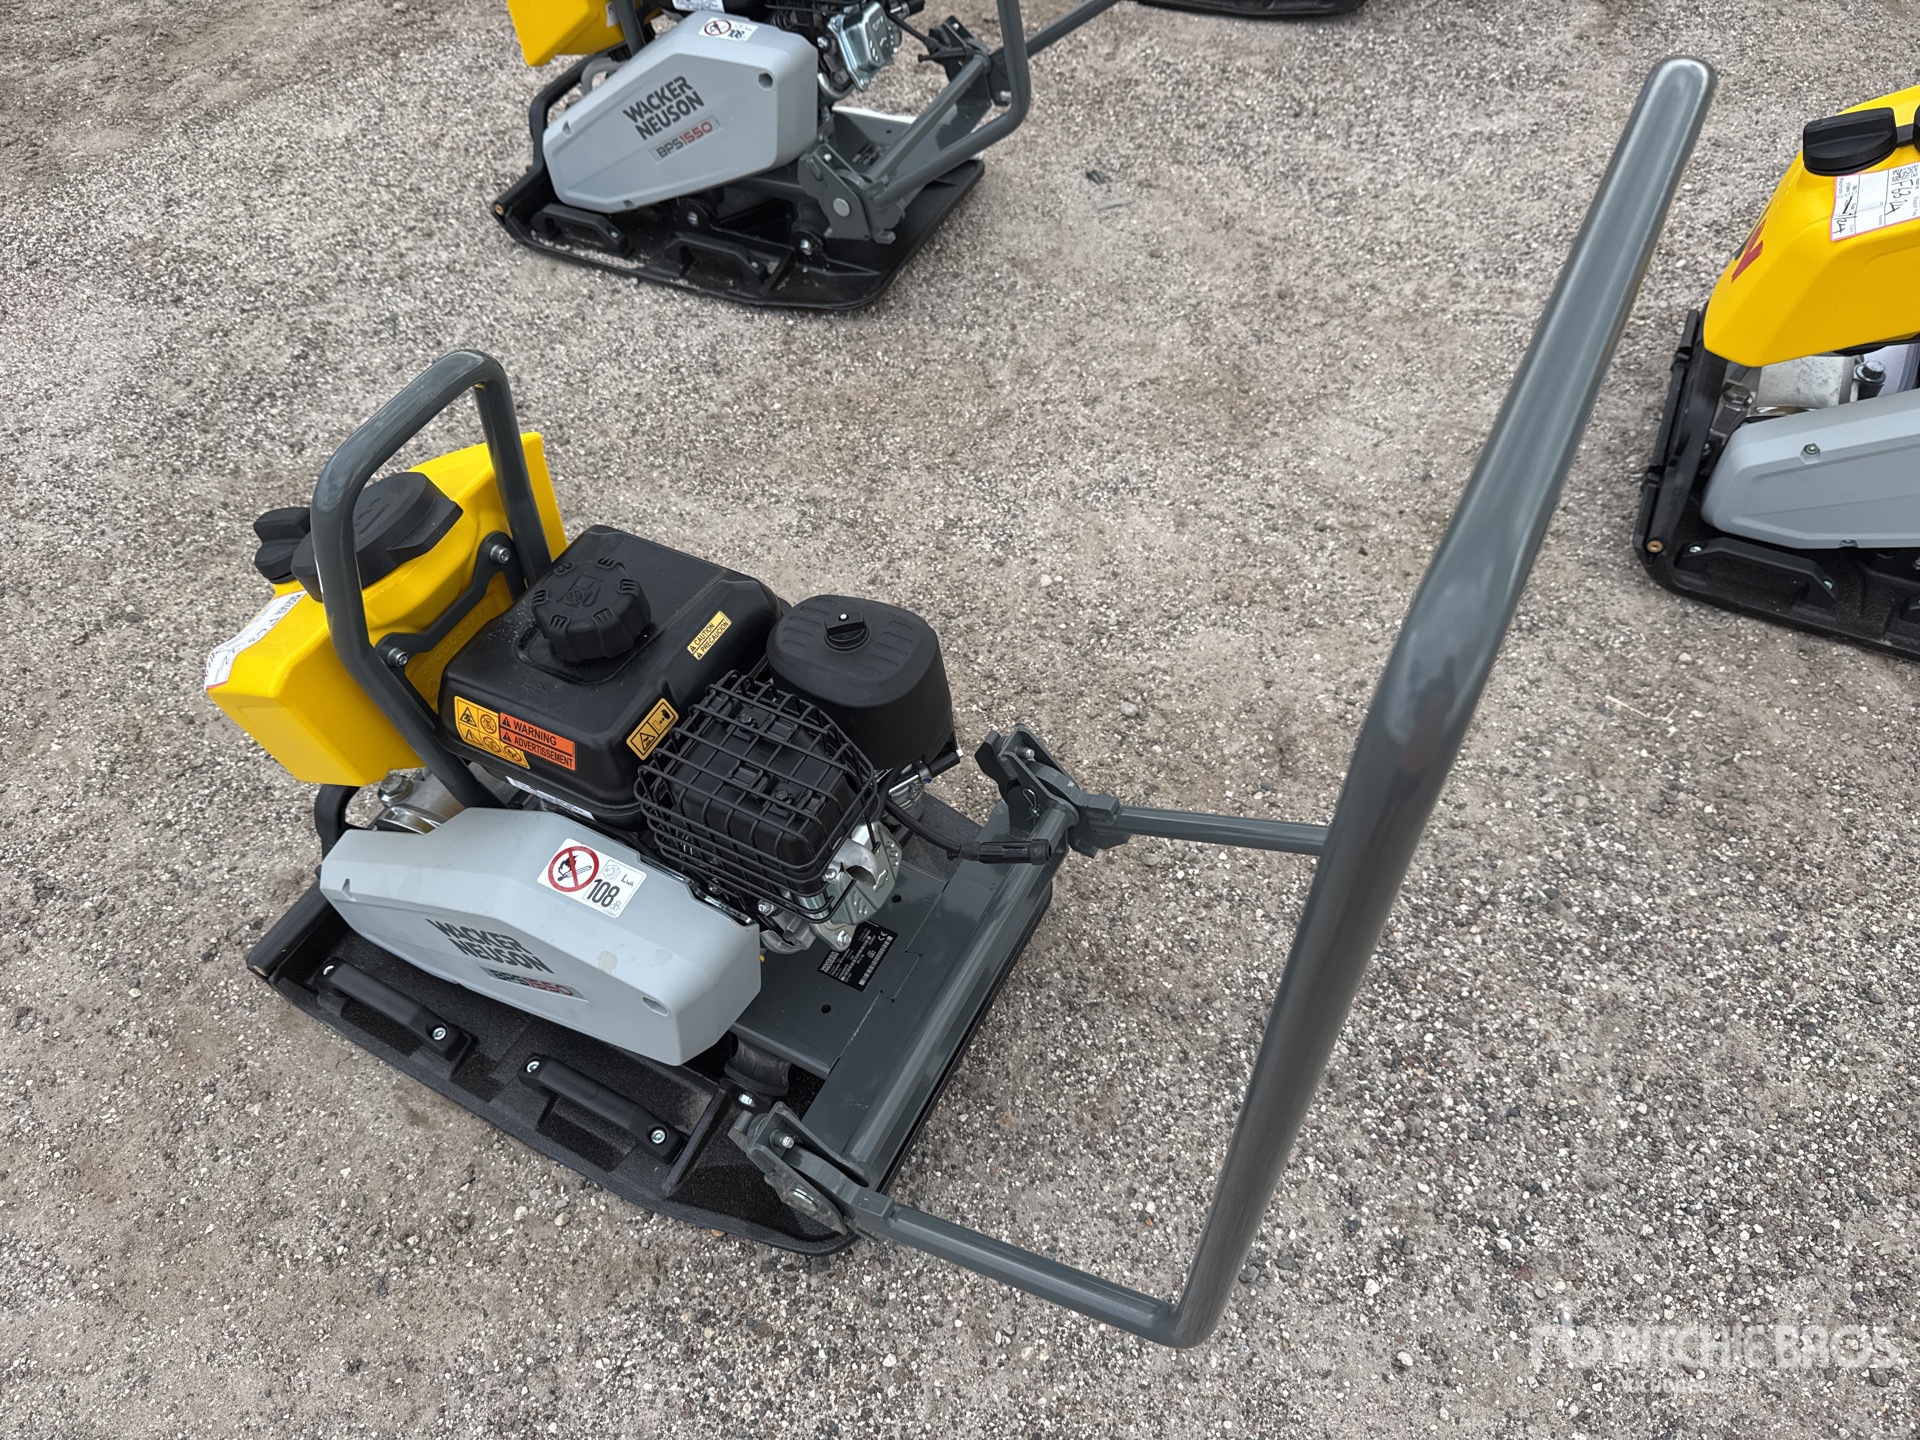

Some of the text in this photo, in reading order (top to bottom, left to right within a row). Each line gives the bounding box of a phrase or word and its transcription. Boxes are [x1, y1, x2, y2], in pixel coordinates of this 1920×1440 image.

[622, 75, 695, 123] WACKER
[635, 90, 705, 141] NEUSON
[656, 121, 714, 159] BPS1550
[693, 622, 716, 646] CAUTION
[513, 719, 557, 746] WARNING
[514, 736, 574, 768] ADVERTISSEMENT
[587, 878, 620, 908] 108
[425, 918, 534, 955] WACKER
[448, 937, 555, 974] NEUSON
[489, 969, 575, 997] BPS1550
